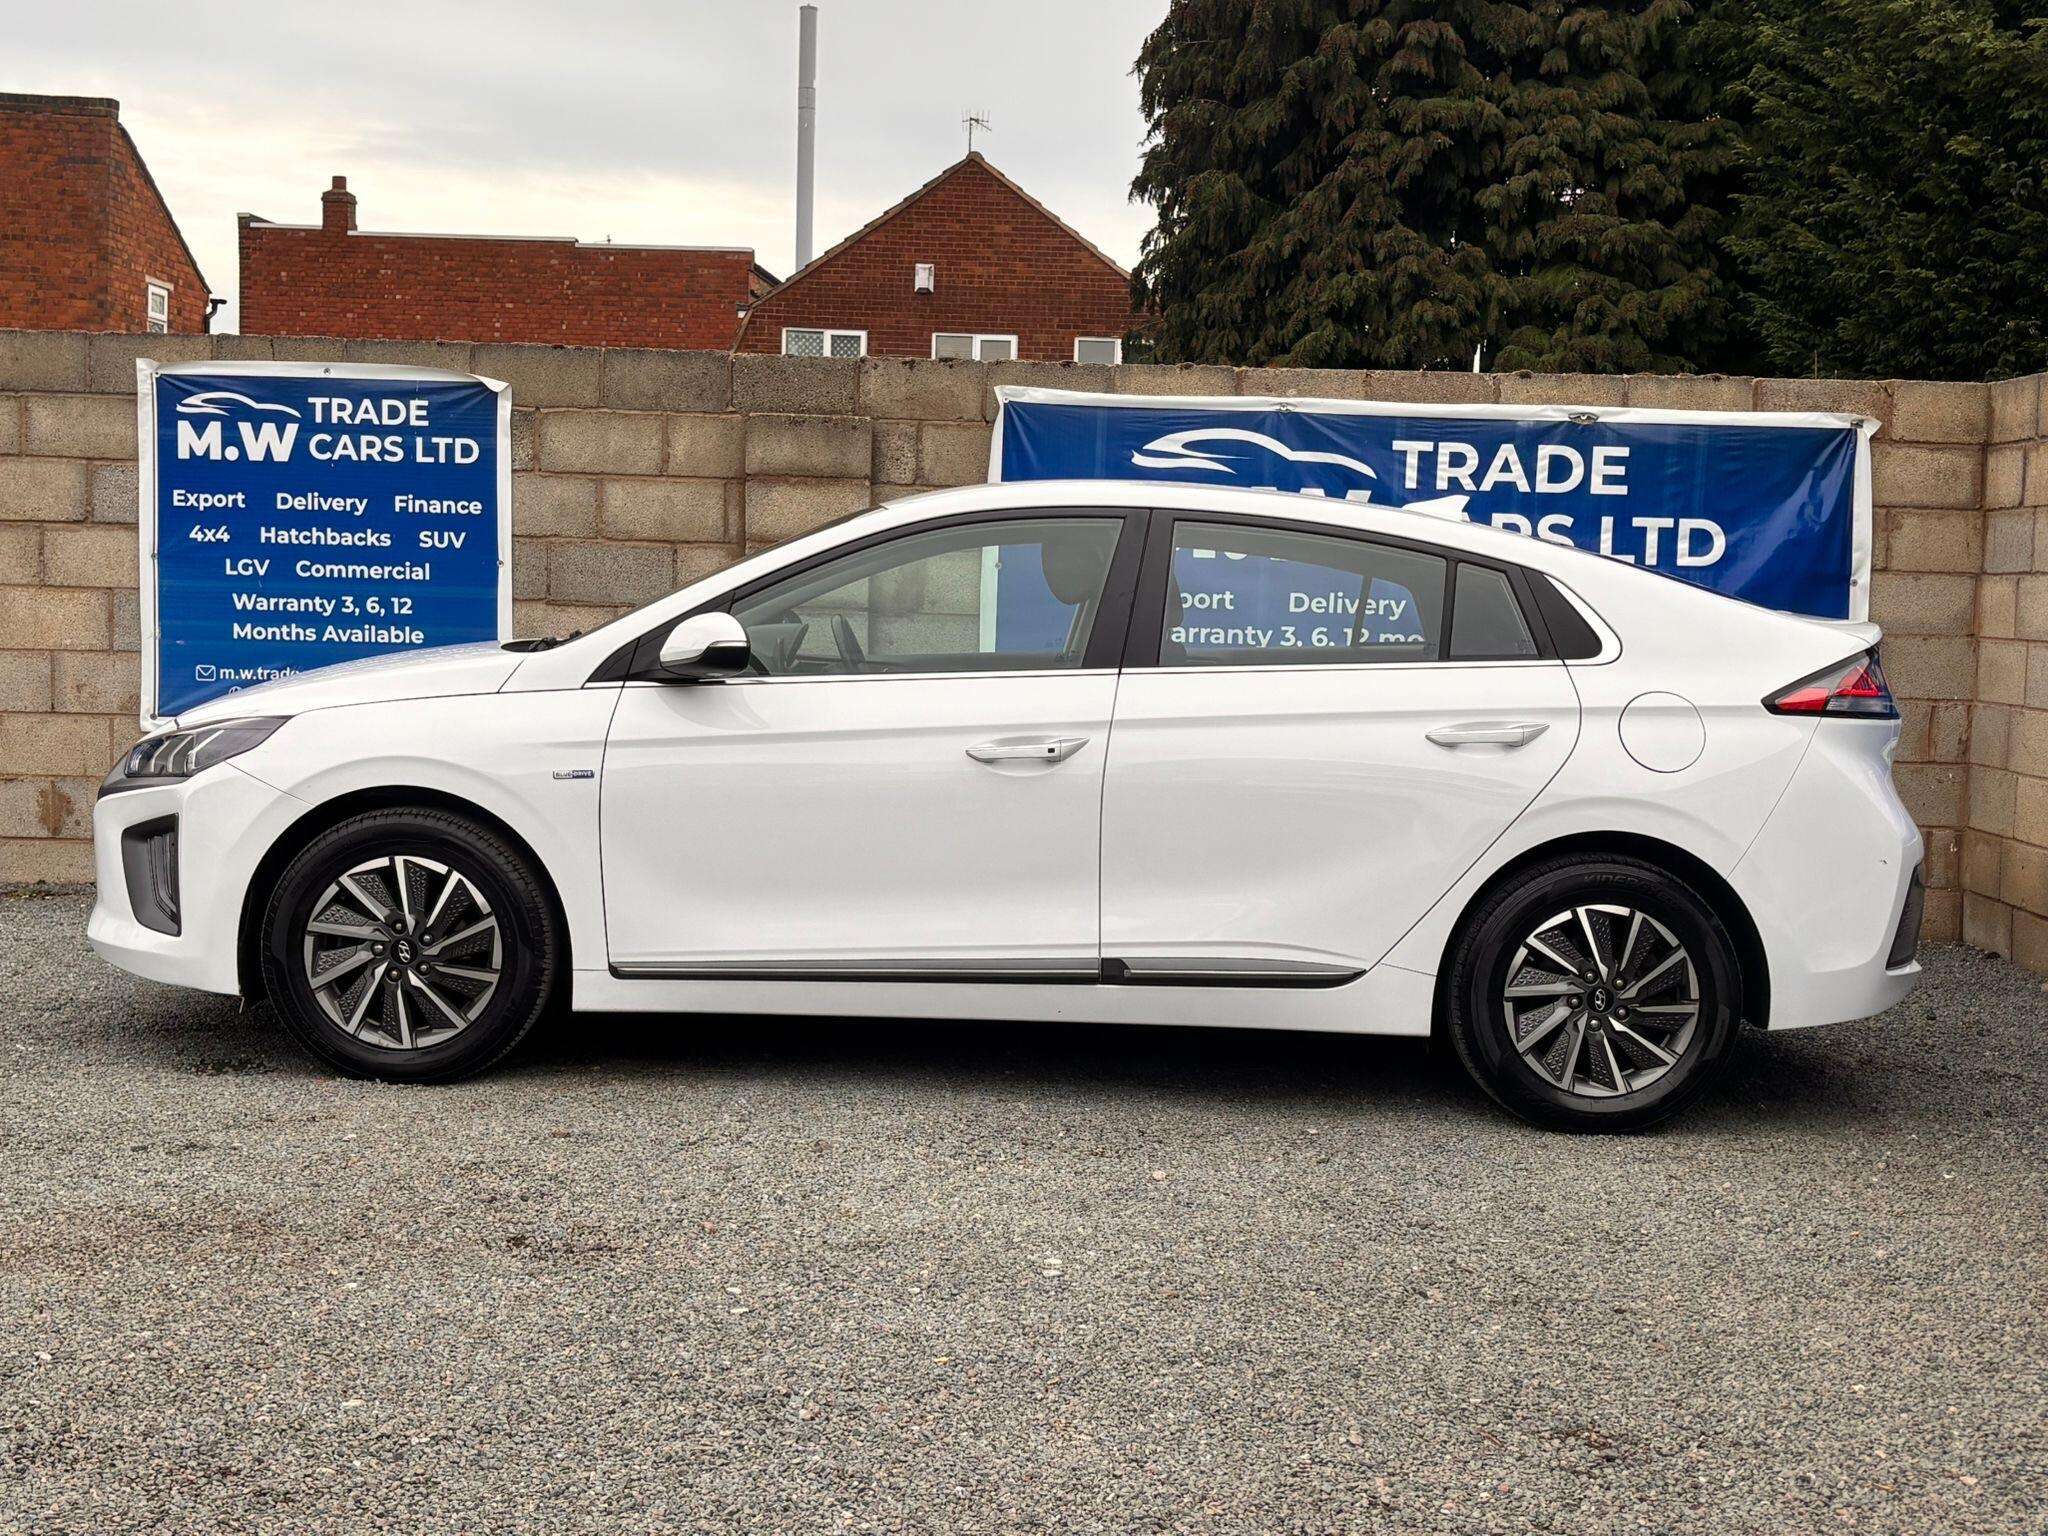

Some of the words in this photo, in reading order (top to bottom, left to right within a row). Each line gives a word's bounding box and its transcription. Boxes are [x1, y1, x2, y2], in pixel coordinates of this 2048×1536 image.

[308, 397, 429, 427] TRADE
[177, 420, 300, 462] M.W
[308, 433, 405, 463] CARS
[415, 436, 480, 464] LTD
[1392, 440, 1630, 495] TRADE
[172, 489, 246, 511] Export
[276, 492, 368, 516] Delivery
[394, 494, 483, 515] Finance
[189, 525, 231, 543] 4x4
[260, 526, 392, 547] Hatchbacks
[419, 530, 467, 549] SUV
[1601, 516, 1727, 567] LTD
[225, 558, 271, 576] LGV
[295, 560, 430, 581] Commercial
[232, 593, 336, 616] Warranty
[341, 596, 360, 616] 3,
[365, 596, 386, 617] 6,
[391, 597, 413, 615] 12
[1288, 592, 1407, 620] Delivery
[233, 623, 317, 642] Months
[321, 624, 425, 644] Available
[1171, 626, 1274, 648] arranty
[219, 667, 300, 681] m.w.trad
